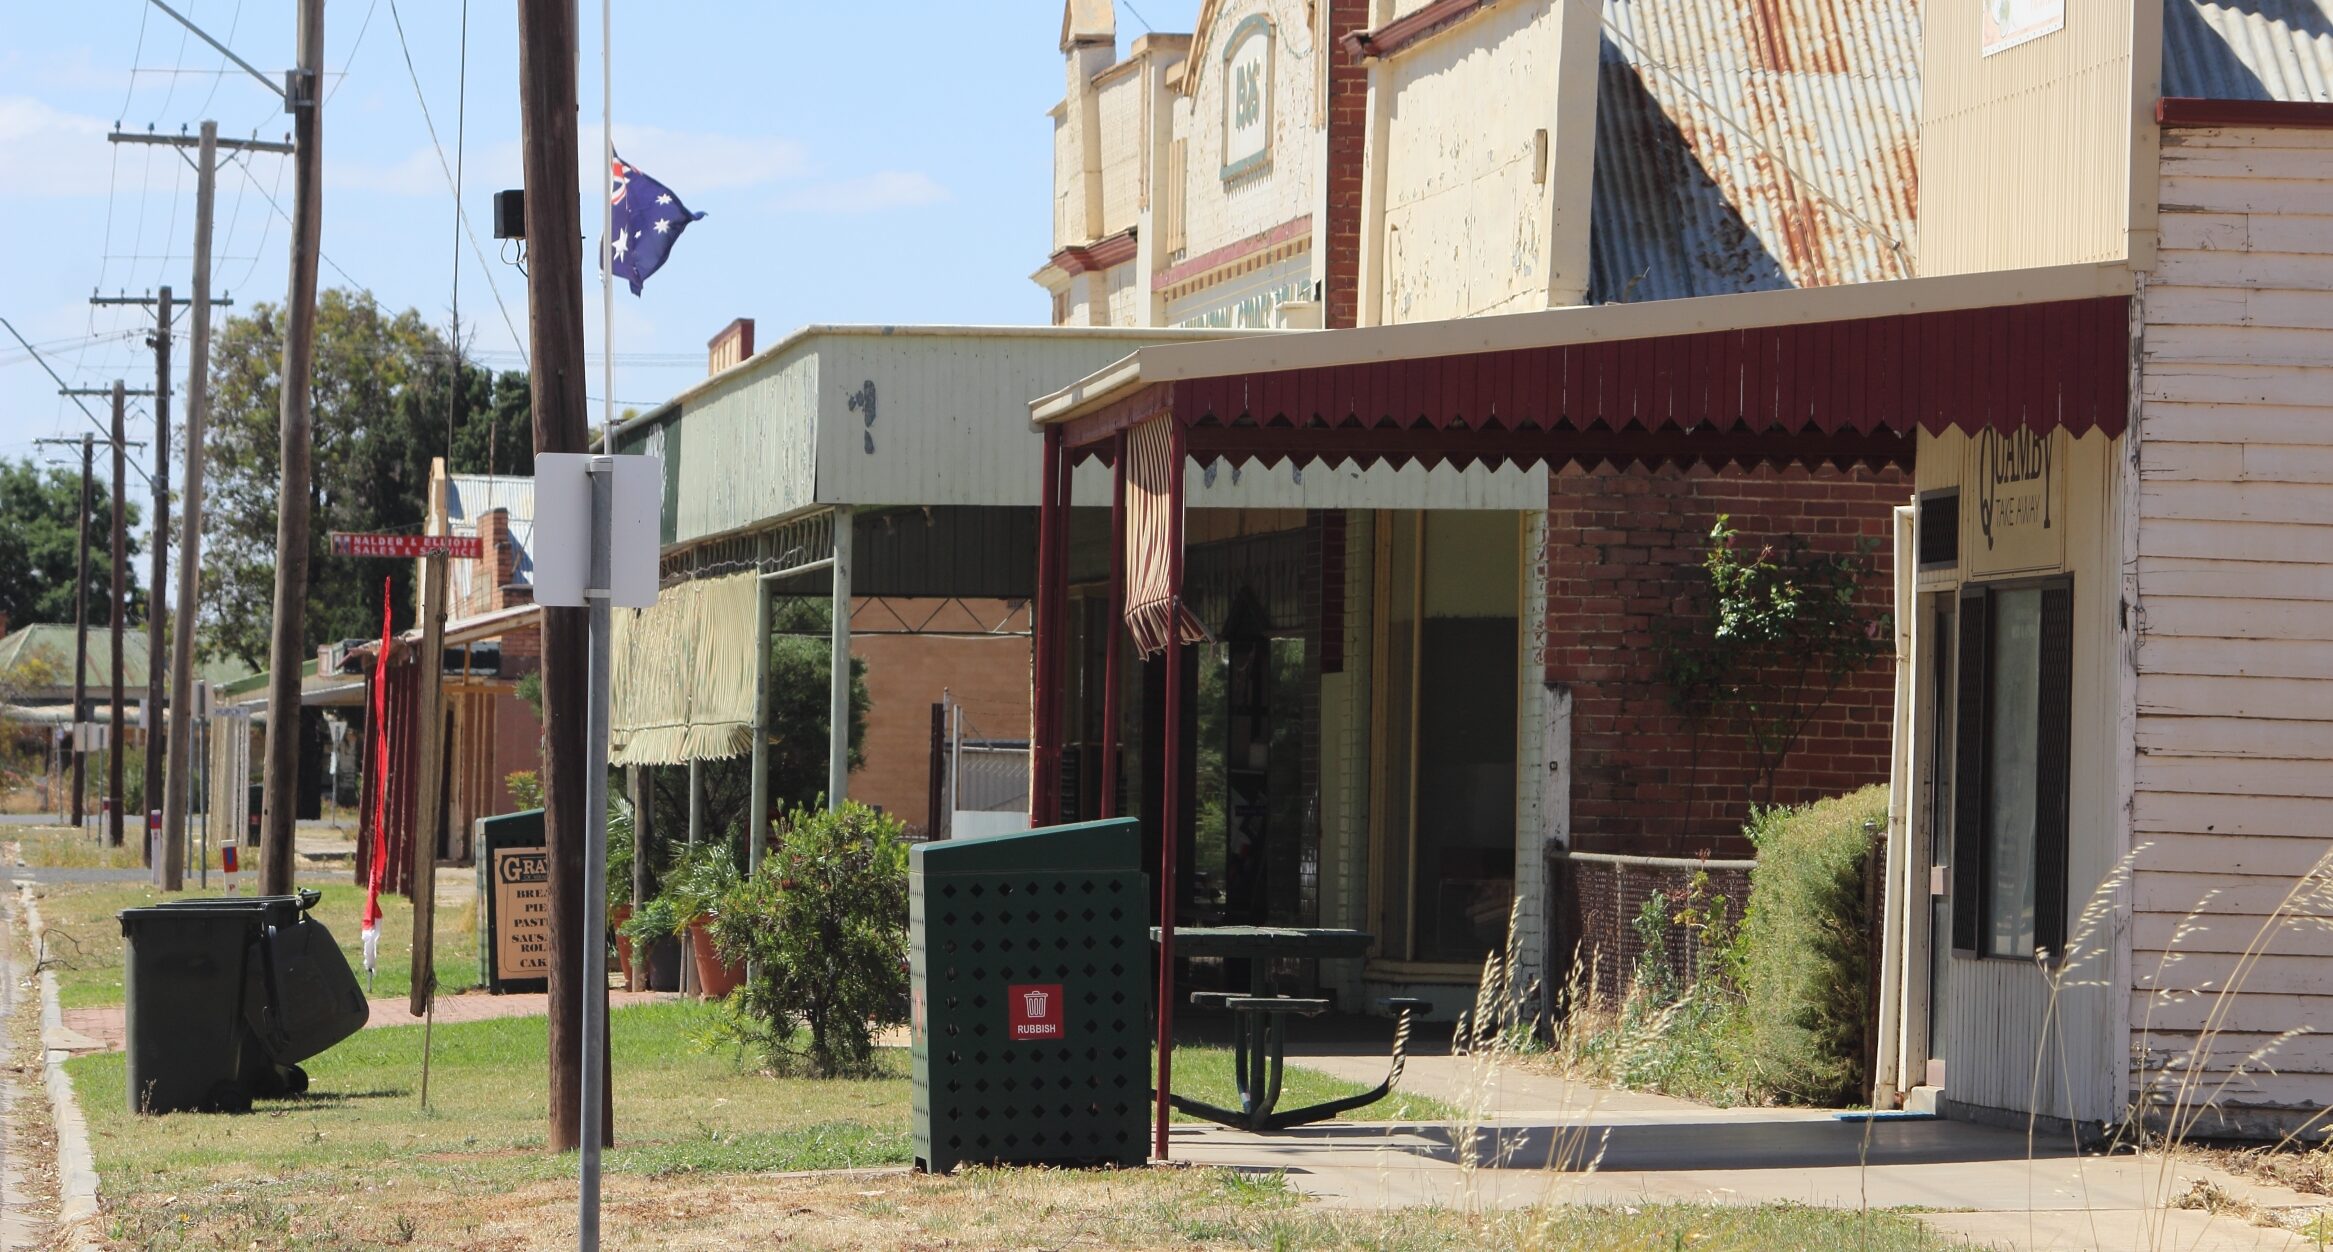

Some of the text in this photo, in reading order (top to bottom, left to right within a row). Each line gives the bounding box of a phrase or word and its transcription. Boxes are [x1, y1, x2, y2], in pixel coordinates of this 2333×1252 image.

[1996, 494, 2040, 528] TAKE AWAY
[353, 535, 404, 547] NALDER
[423, 537, 477, 548] ELLIOTT
[353, 546, 397, 556] SALES
[503, 856, 548, 881] GRA
[1017, 1024, 1056, 1034] RUBBISH
